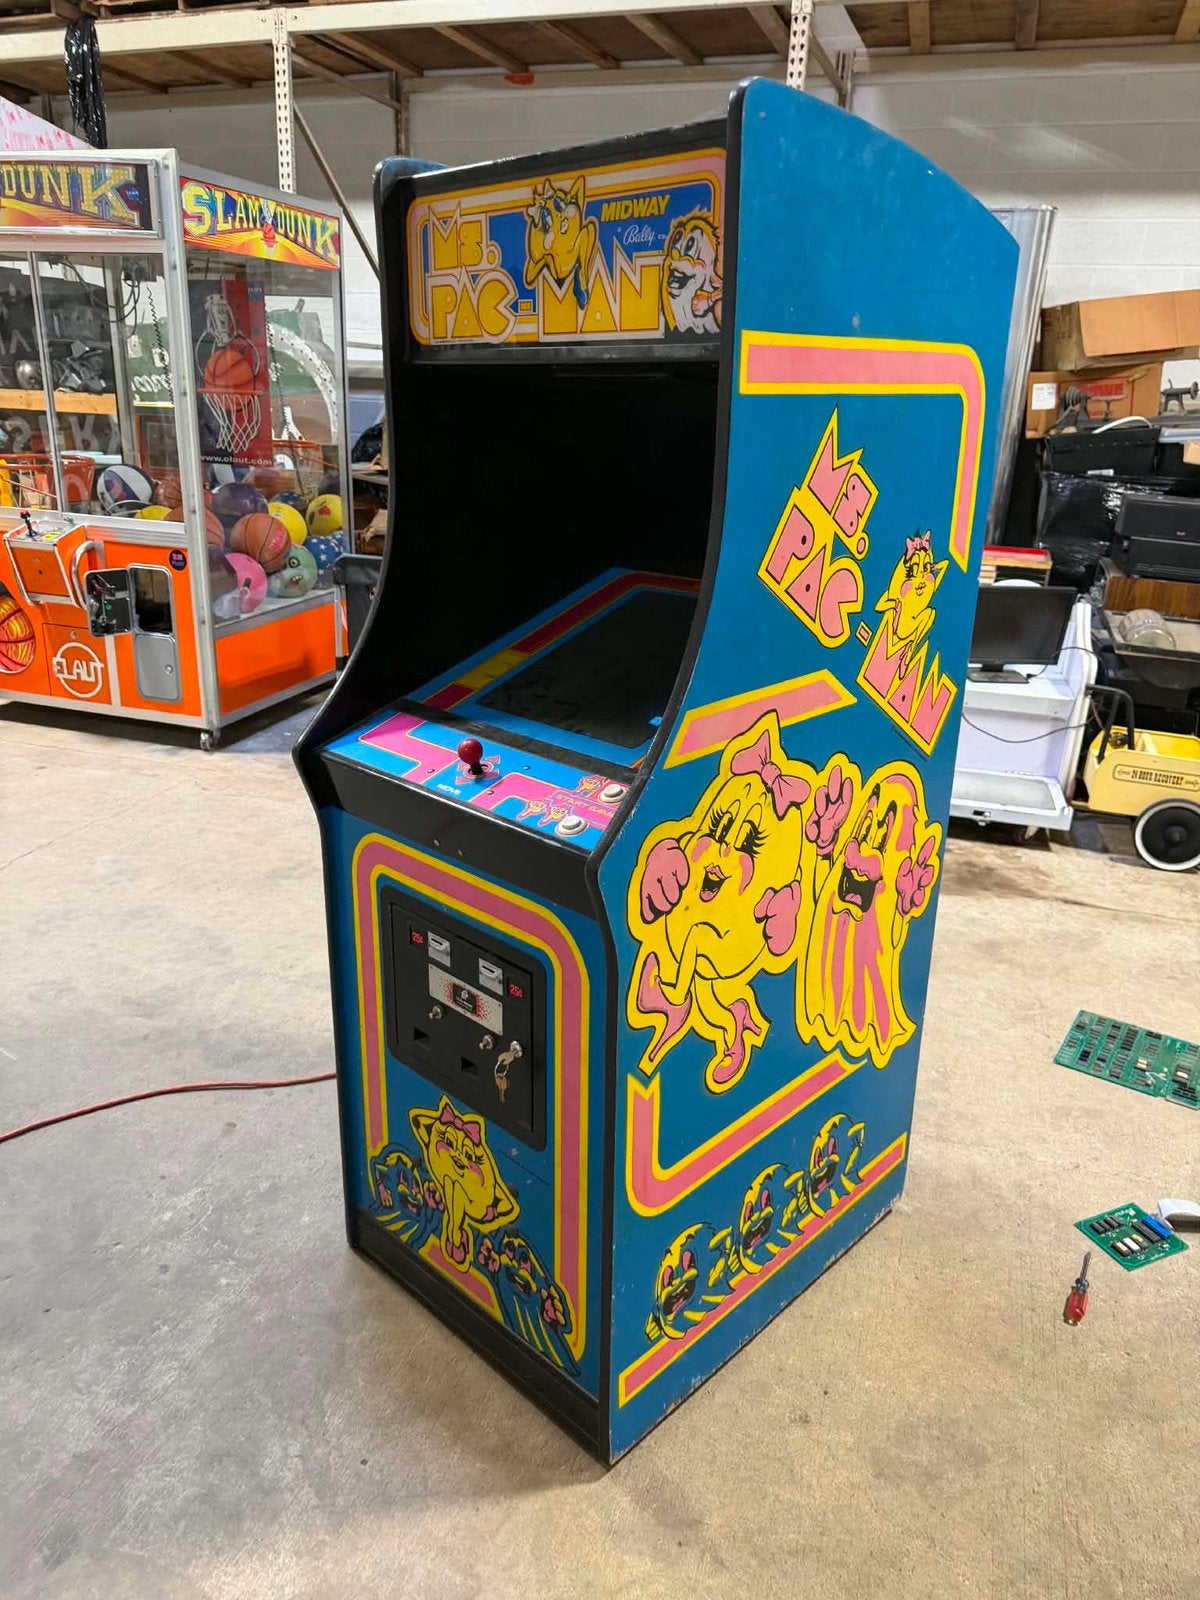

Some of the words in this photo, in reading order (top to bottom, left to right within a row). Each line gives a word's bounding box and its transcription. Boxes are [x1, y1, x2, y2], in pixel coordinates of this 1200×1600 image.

[600, 194, 671, 222] MIDWAY
[181, 181, 261, 238] SLAM
[275, 206, 340, 268] DUNK
[623, 224, 655, 246] Bally
[52, 656, 105, 683] ELAUT
[1138, 770, 1154, 782] HOUR
[1154, 772, 1185, 786] RECOVERY
